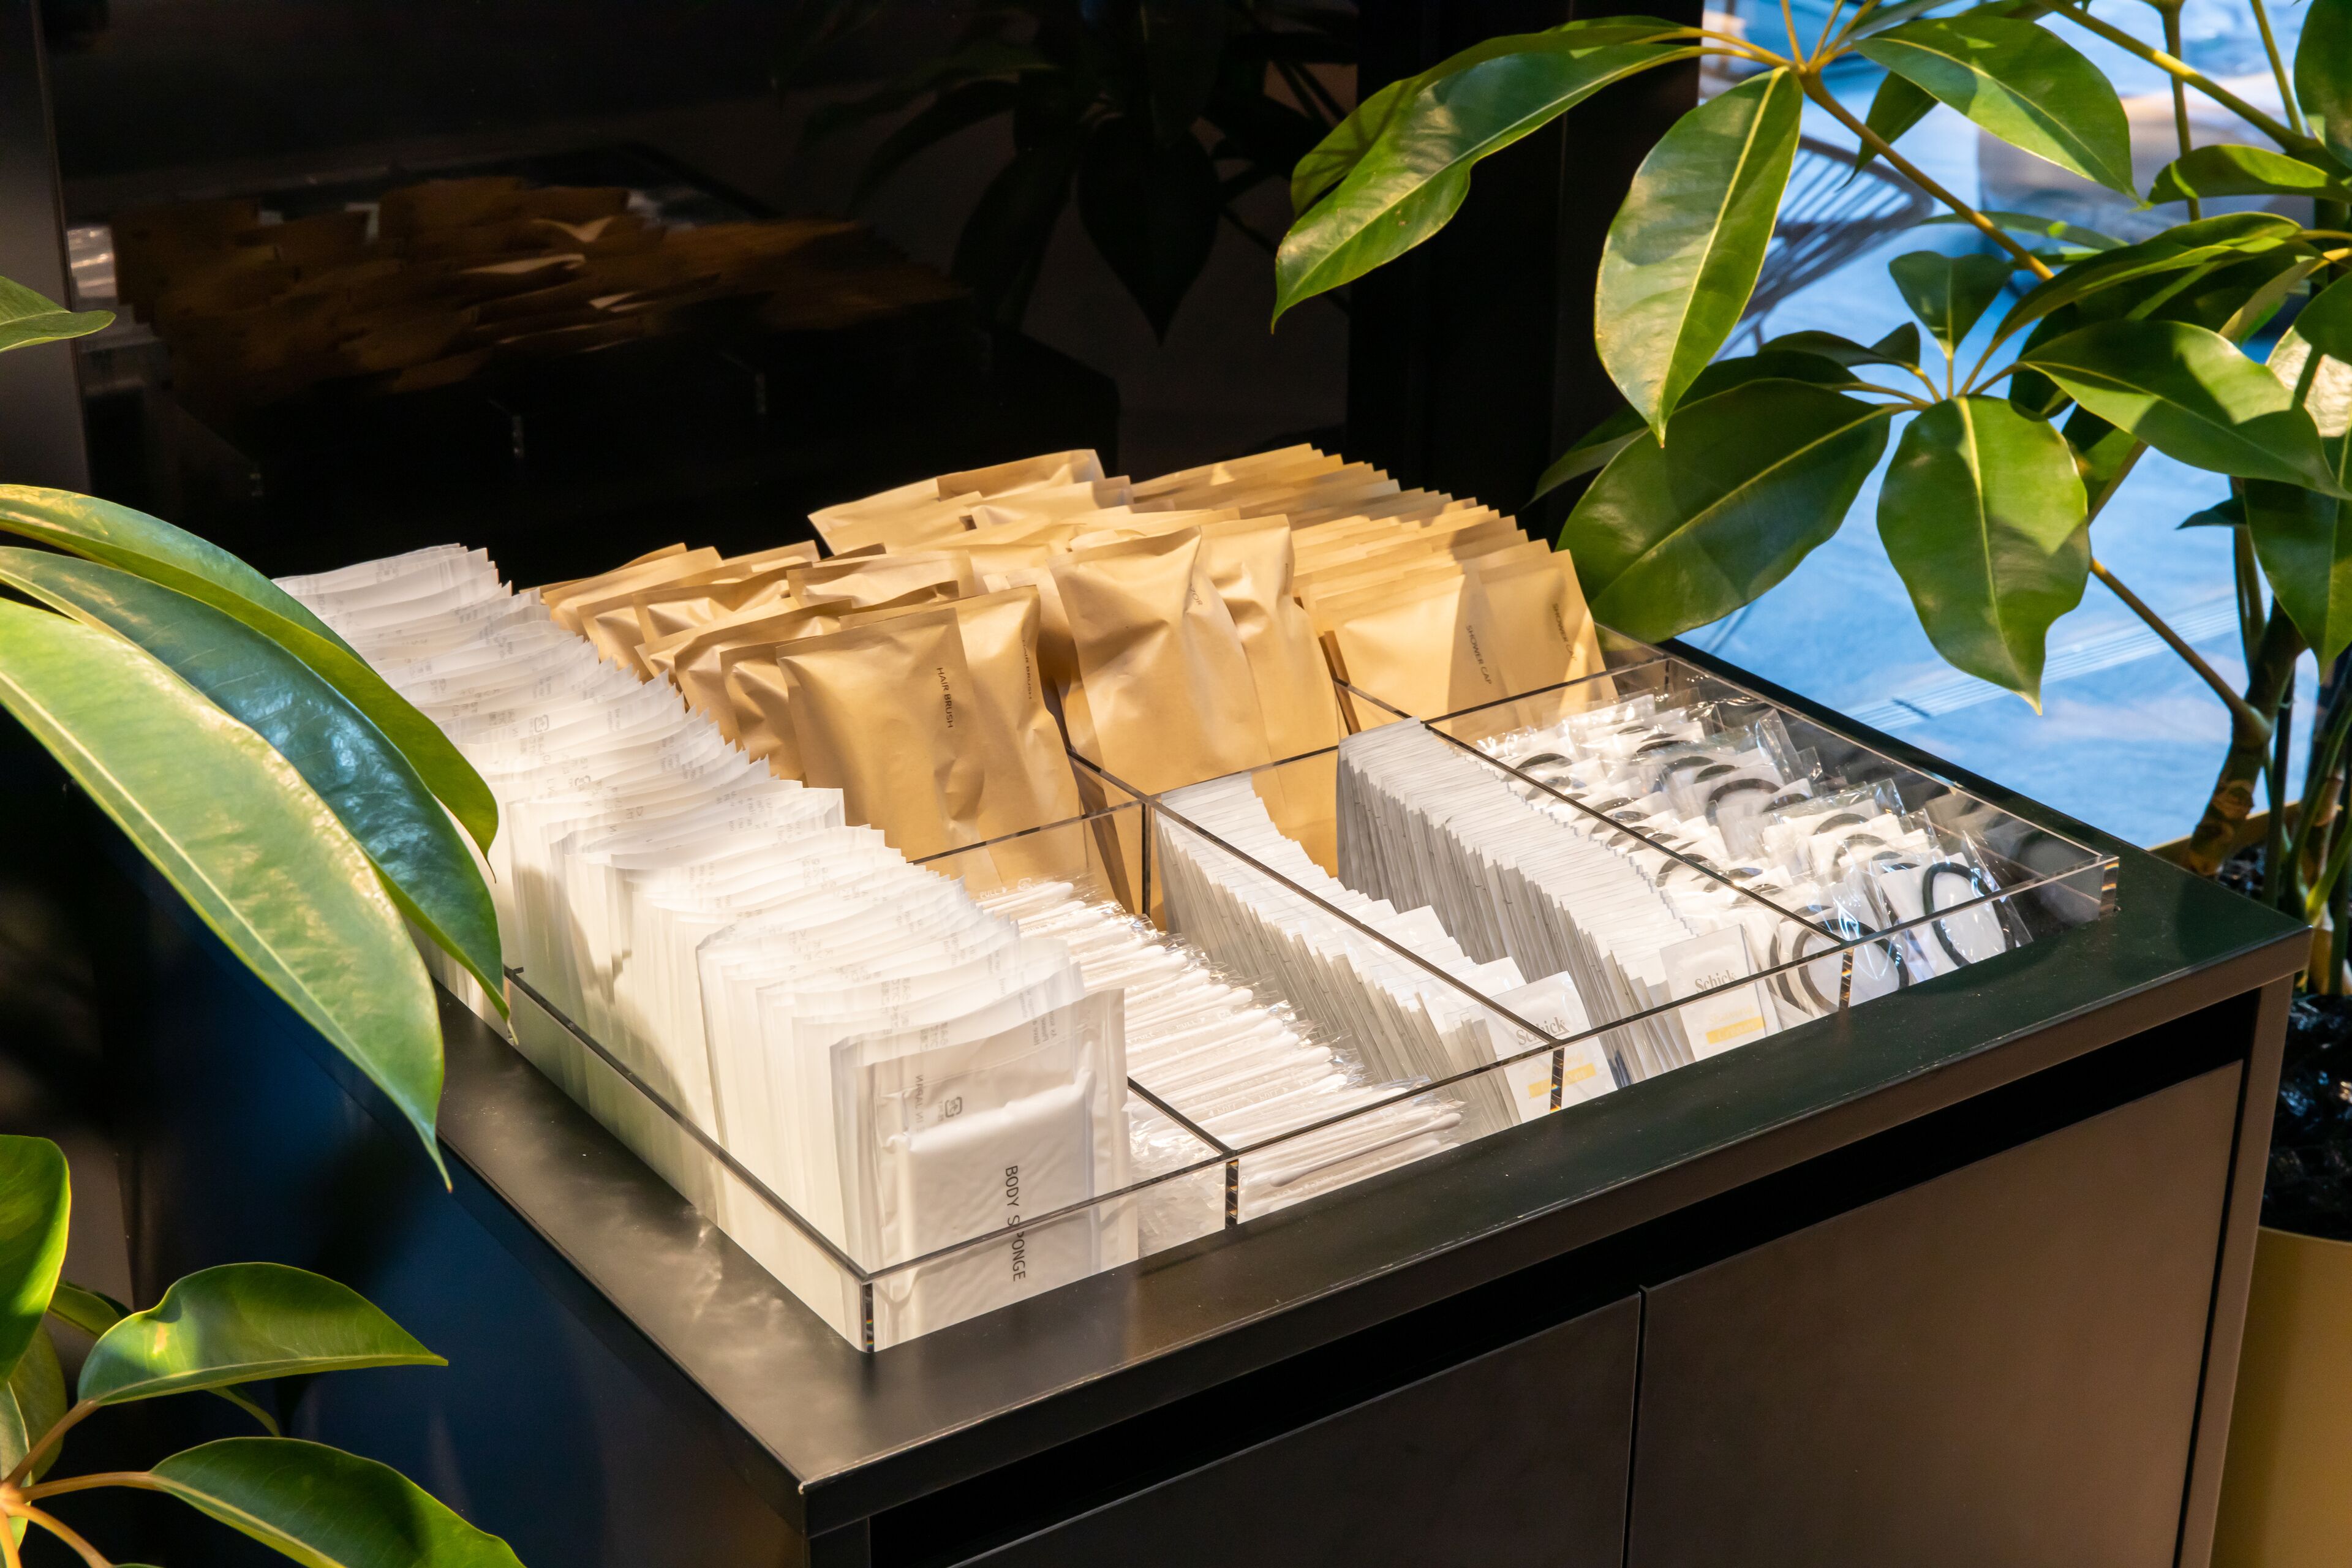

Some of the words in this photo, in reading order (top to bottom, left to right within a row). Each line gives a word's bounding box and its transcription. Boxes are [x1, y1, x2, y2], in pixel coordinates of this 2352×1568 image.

[1552, 603, 1569, 643] SHOWER
[1466, 625, 1484, 665] SHOWER
[1480, 666, 1492, 685] CAP
[937, 667, 949, 692] HAIR
[944, 694, 954, 728] BRUSH
[980, 889, 1000, 899] PULL
[1695, 970, 1736, 993] Schick
[1516, 1017, 1570, 1045] Scick
[1005, 1165, 1020, 1207] BODY
